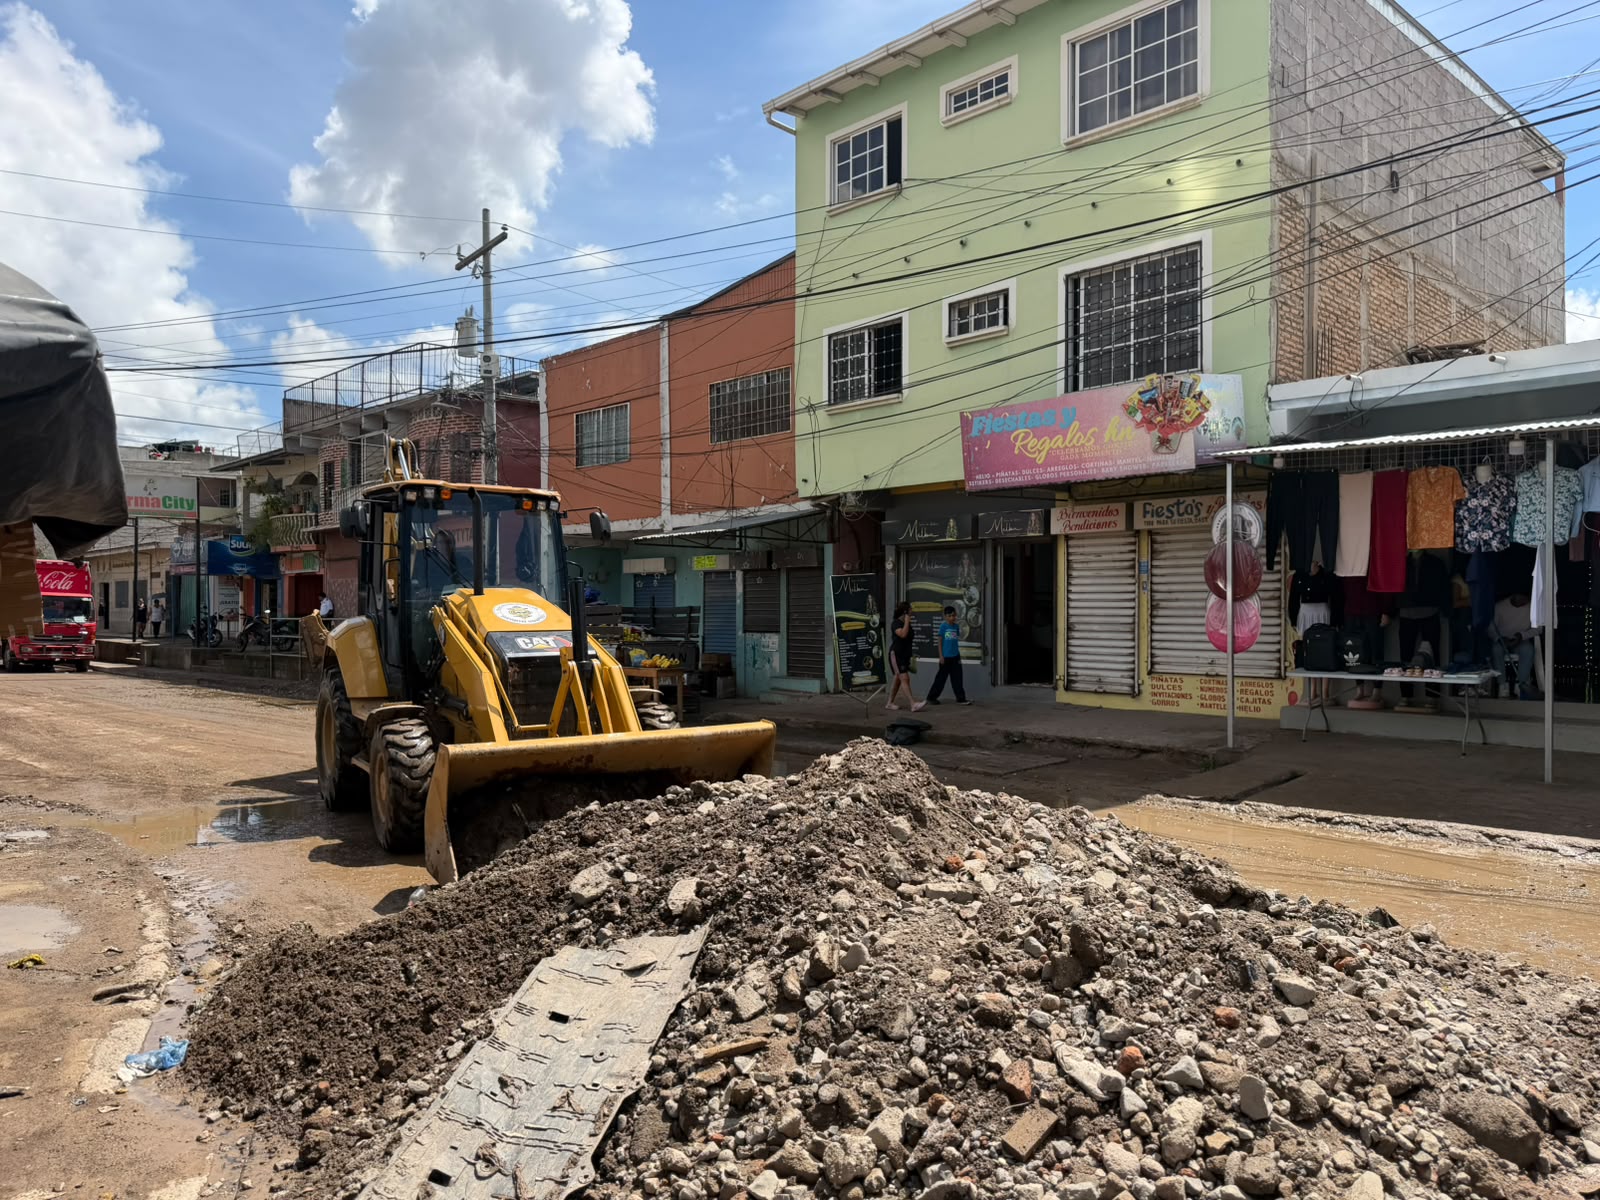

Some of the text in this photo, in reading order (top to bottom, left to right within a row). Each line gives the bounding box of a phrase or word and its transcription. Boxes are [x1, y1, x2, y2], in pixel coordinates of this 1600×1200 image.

[970, 406, 1077, 438] Fiestas y
[1010, 421, 1098, 464] Regalos
[127, 495, 195, 510] rmaCity
[1057, 505, 1119, 521] Bienvenidos
[40, 571, 77, 590] Cola
[515, 637, 557, 649] CAT
[1151, 683, 1183, 691] DULCES
[1240, 681, 1274, 689] ARREGLOS
[1151, 691, 1193, 700] INVITACIONES
[1240, 688, 1274, 697] REGALOS
[1151, 699, 1180, 707] GORROS
[1200, 694, 1226, 703] GLOBOS
[1240, 697, 1272, 705] CAJITAS
[1200, 702, 1227, 710] MANTELE
[1239, 705, 1262, 713] HELIO
